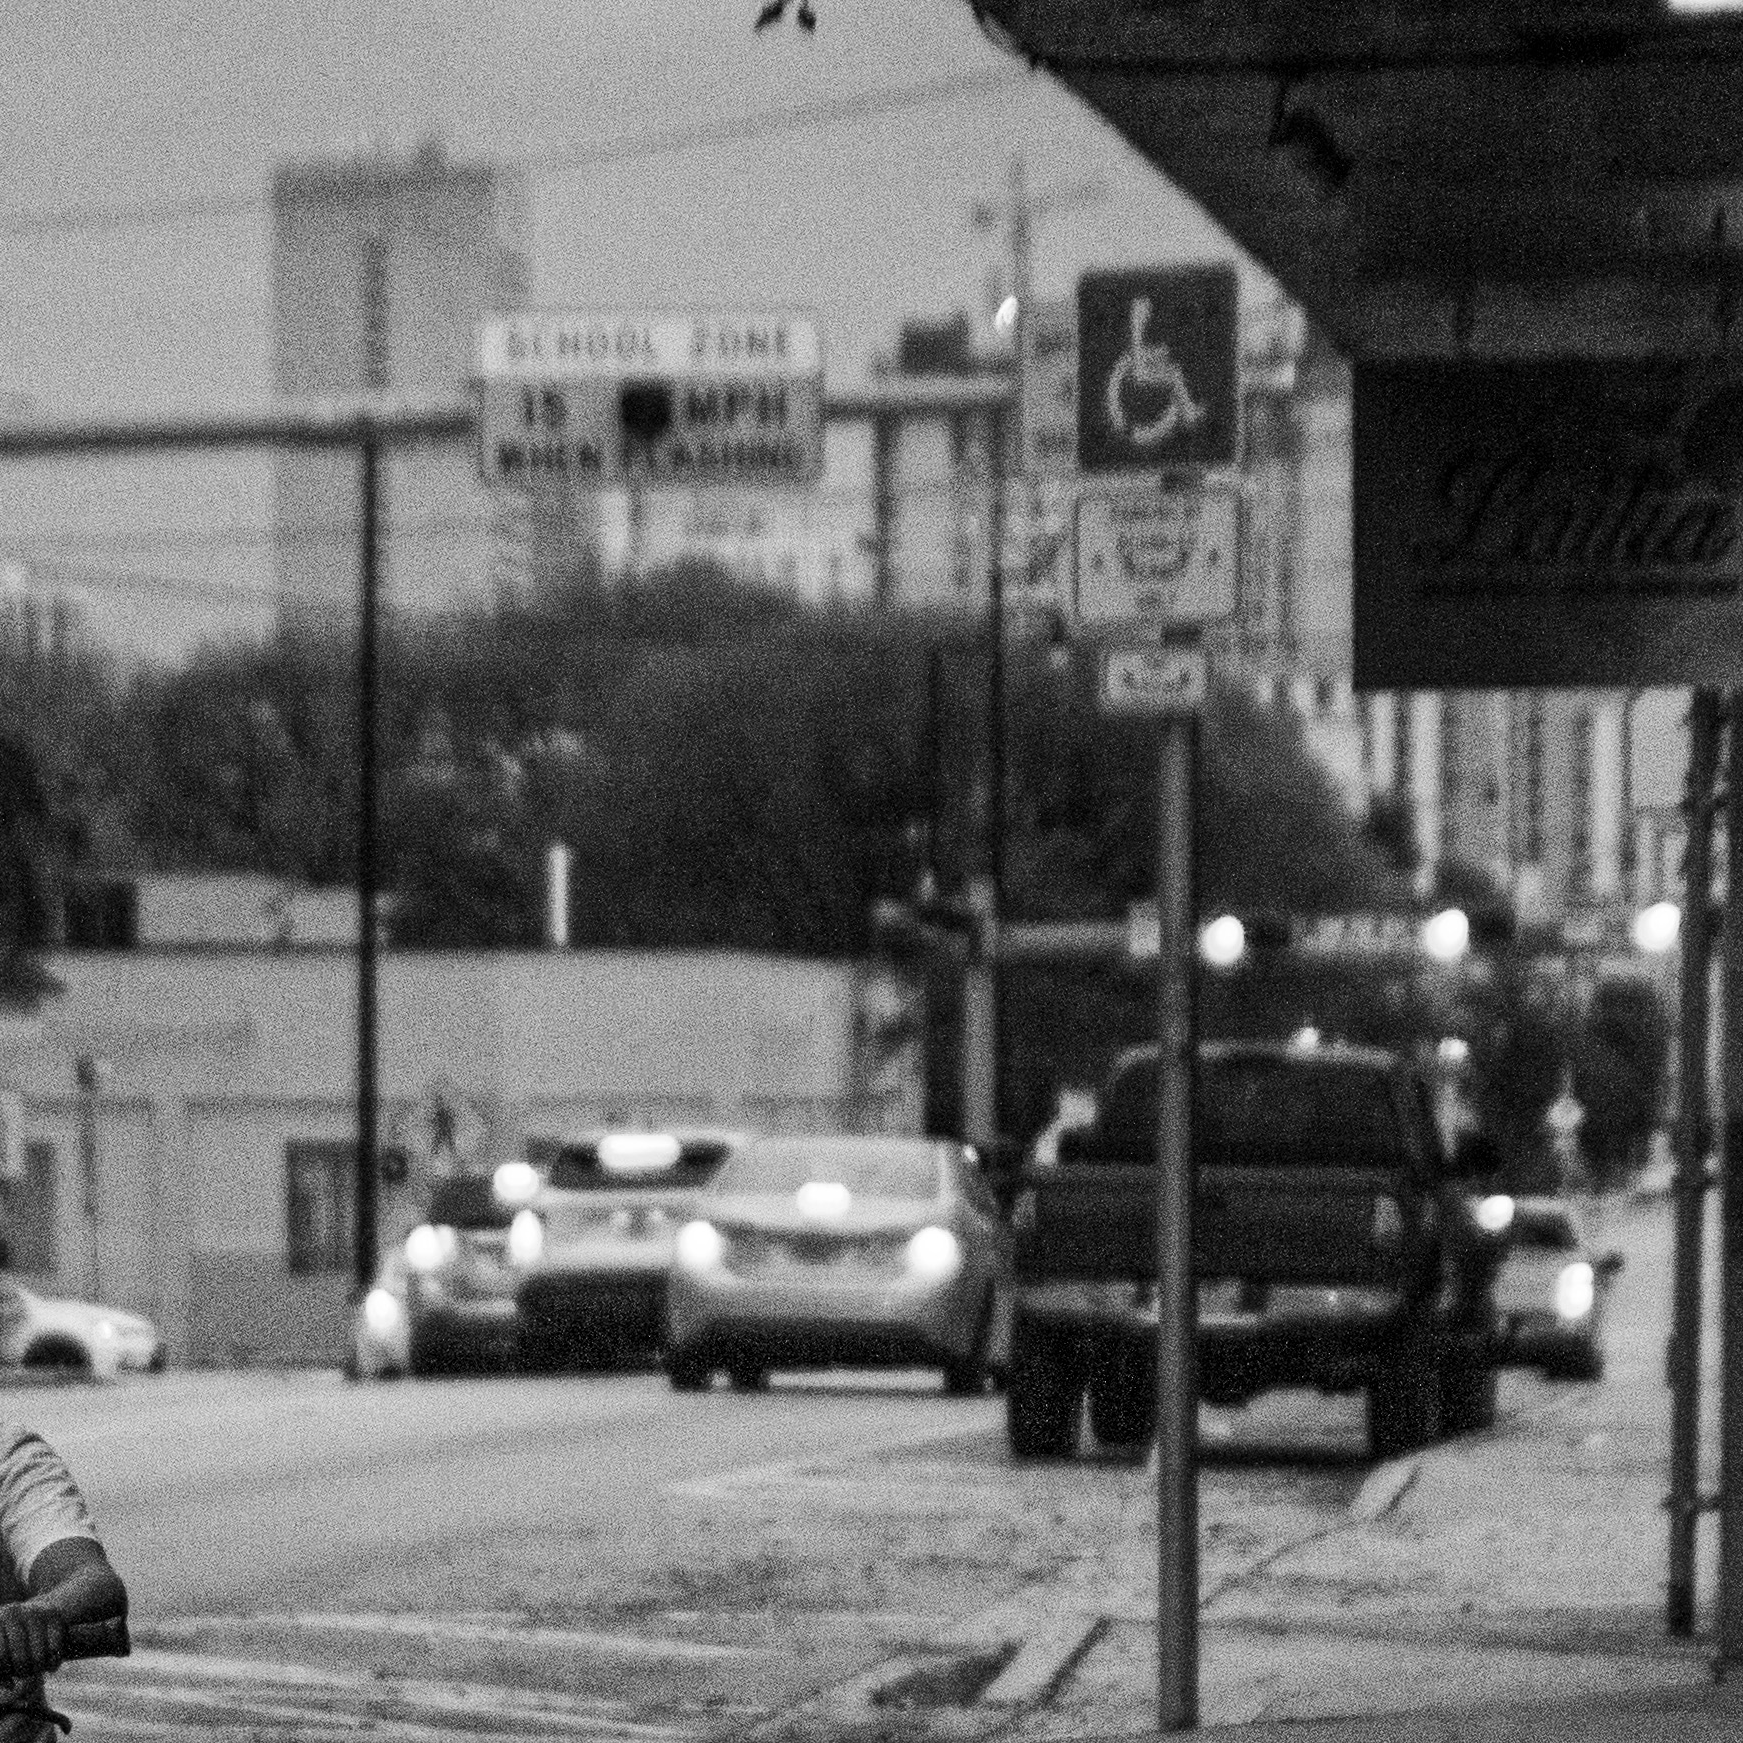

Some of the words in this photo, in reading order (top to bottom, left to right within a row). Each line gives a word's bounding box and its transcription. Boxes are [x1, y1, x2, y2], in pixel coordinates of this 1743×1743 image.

[505, 329, 658, 361] SCHOOL
[691, 328, 791, 358] ZONE
[685, 387, 789, 425] MPH
